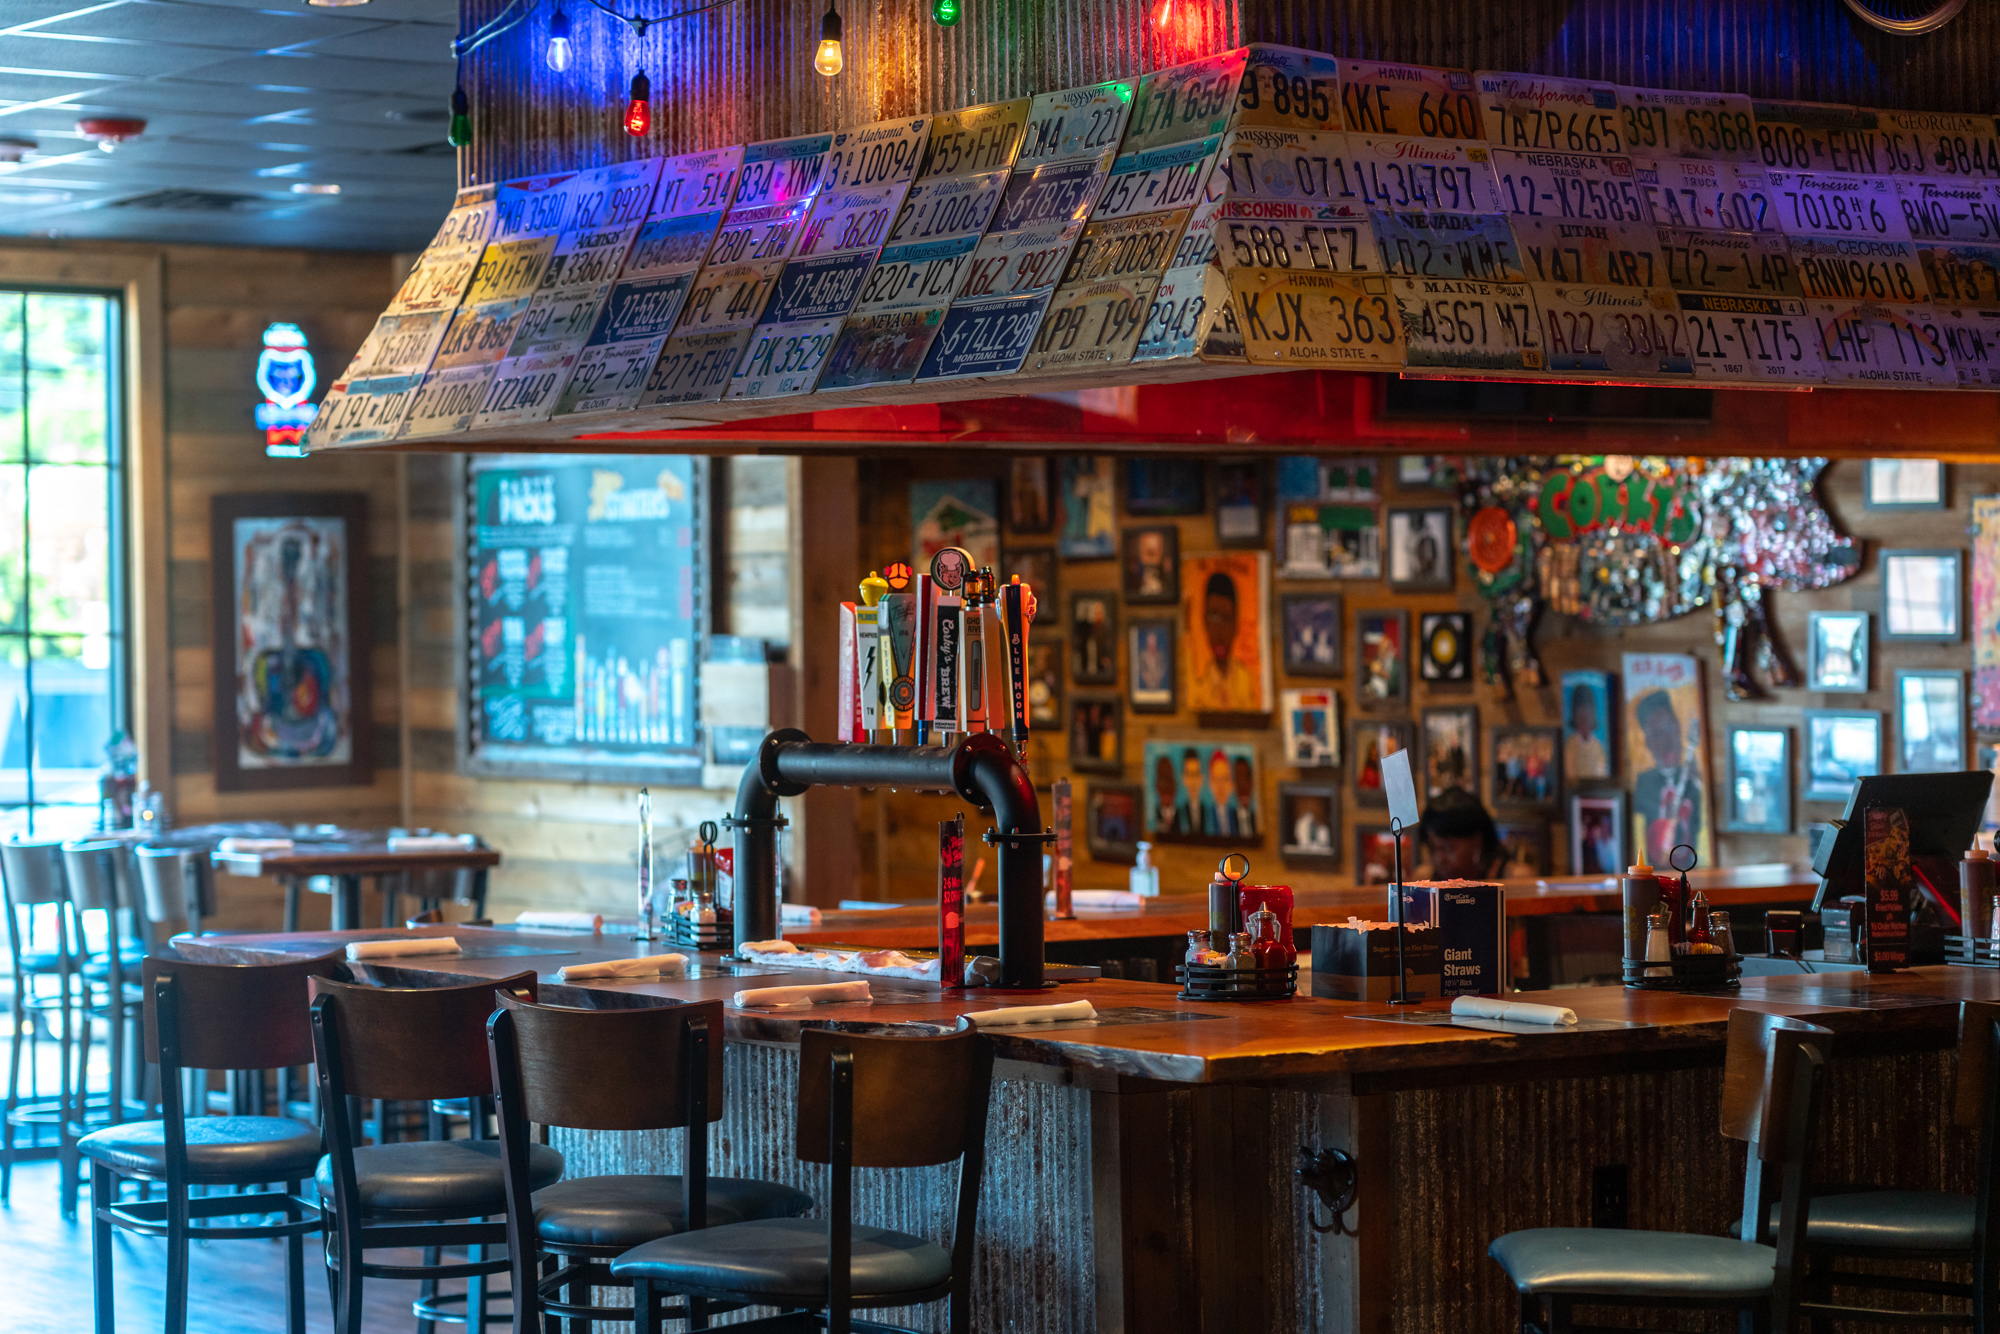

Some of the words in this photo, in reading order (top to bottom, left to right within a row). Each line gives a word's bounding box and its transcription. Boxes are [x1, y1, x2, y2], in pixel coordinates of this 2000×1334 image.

[1378, 67, 1422, 82] HAWAII
[1451, 73, 1469, 85] NOV
[1063, 87, 1106, 108] MISSISSIPPI
[1272, 72, 1330, 122] 895
[1482, 80, 1500, 93] MAY
[1508, 80, 1594, 108] California
[1643, 93, 1661, 104] LIVE
[1664, 95, 1686, 105] FREE
[1689, 96, 1702, 106] OR
[1705, 97, 1719, 107] DIE
[1131, 89, 1177, 136] 17A
[1182, 74, 1231, 122] 659
[951, 114, 975, 128] New
[974, 109, 1004, 124] Jersey
[1418, 91, 1477, 139] 660
[1083, 101, 1124, 149] 221
[1490, 105, 1621, 153] 7AZP665
[1622, 105, 1670, 148] 397
[1685, 109, 1754, 152] 6368
[852, 126, 905, 146] Alabama
[1236, 131, 1299, 149] MISSISSIPPI
[1374, 141, 1457, 161] Illinois
[1757, 125, 1811, 169] 808
[1827, 130, 1877, 174] EHV
[684, 153, 719, 170] MISSISSIPPI
[850, 137, 922, 186] 10094
[1528, 154, 1599, 170] NEBRASKA
[1616, 162, 1628, 174] 10
[1680, 163, 1716, 176] TEXAS
[607, 169, 640, 184] Illinois
[736, 162, 776, 204] 834
[783, 154, 826, 197] XNM
[1036, 167, 1068, 178] TREASURE
[1069, 165, 1089, 174] STATE
[1295, 157, 1357, 198] 071
[1549, 168, 1582, 178] TRAILER
[1769, 173, 1784, 187] SEP
[528, 178, 550, 191] OHIO
[698, 168, 736, 208] 514
[926, 178, 982, 198] Alabama
[1097, 170, 1151, 215] 457
[1154, 159, 1205, 207] XDA
[1684, 176, 1719, 189] TRUCK
[1796, 173, 1861, 191] Tennessee
[1503, 174, 1642, 222] 12-X2585
[1918, 183, 1983, 200] Tennessee
[609, 184, 650, 225] 9922
[831, 191, 882, 211] Illinois
[524, 192, 568, 232] 3580
[726, 206, 774, 224] WISCONSIN
[920, 190, 996, 237] 10063
[1212, 202, 1297, 220] WISCONSIN
[1717, 191, 1776, 233] 602
[1784, 191, 1852, 232] 7018
[1018, 216, 1063, 229] MONTANA
[1102, 216, 1165, 236] ARKANSAS
[1402, 214, 1474, 231] NEVADA
[573, 230, 621, 250] Arkansas
[1558, 224, 1609, 240] UTAH
[1685, 231, 1751, 249] Tennessee
[1000, 233, 1059, 250] Illinois
[1229, 224, 1368, 272] 588-EFZ
[1836, 240, 1910, 258] GEORGIA
[805, 258, 835, 268] TREASURE
[836, 256, 855, 265] STATE
[1088, 229, 1175, 280] 270081
[562, 246, 626, 286] 336613
[723, 265, 753, 279] HAWAII
[957, 255, 1009, 298] X62
[1009, 244, 1069, 294] 9922
[660, 278, 676, 286] STATE
[862, 263, 911, 304] 820
[918, 256, 968, 298] VCX
[1287, 274, 1334, 289] HAWAII
[1802, 257, 1916, 300] RNW9618
[549, 291, 590, 305] Tennessee
[1086, 282, 1120, 297] HAWAII
[1423, 281, 1491, 296] MAINE
[1505, 286, 1524, 297] JULY
[1563, 288, 1643, 308] Illinois
[681, 285, 723, 327] KPC
[725, 278, 774, 321] 447
[788, 306, 828, 317] MONTANA
[834, 303, 845, 312] 10
[972, 302, 1007, 313] TREASURE
[1008, 301, 1028, 309] STATE
[1703, 296, 1772, 313] NEBRASKA
[1788, 302, 1796, 313] 4
[867, 311, 919, 330] NEVADA
[1095, 295, 1147, 348] 199
[1241, 291, 1314, 342] KJX
[1329, 295, 1396, 345] 363
[1422, 300, 1488, 345] 4567
[1496, 302, 1539, 348] MZ
[616, 325, 651, 336] MONTANA
[1547, 309, 1603, 354] A22
[1688, 315, 1802, 361] 21-T175
[682, 333, 703, 347] New
[701, 333, 731, 348] Jersey
[1889, 321, 1948, 366] 113
[599, 347, 642, 362] Tennessee
[775, 333, 833, 374] 3529
[952, 352, 997, 364] MONTANA
[1005, 349, 1016, 358] 10
[1050, 352, 1079, 363] ALOHA
[1078, 350, 1106, 361] STATE
[1150, 347, 1168, 356] STATE
[1289, 346, 1327, 359] ALOHA
[1331, 347, 1366, 359] STATE
[1526, 353, 1539, 364] 16
[523, 358, 562, 372] Illinois
[646, 352, 695, 392] S27
[691, 347, 738, 389] FHB
[1724, 363, 1743, 374] 1867
[1766, 365, 1786, 376] 2017
[1971, 368, 1981, 377] 15
[566, 355, 657, 397] F92-75N
[1859, 370, 1891, 380] ALOHA
[1893, 371, 1923, 382] STATE
[745, 381, 764, 396] MEX
[777, 377, 797, 393] MEX
[581, 398, 611, 410] BLOUNT
[656, 392, 682, 405] Garden
[682, 389, 704, 402] State
[940, 619, 955, 664] Corky's
[1012, 634, 1021, 675] BLUE
[940, 667, 952, 709] BREW
[1014, 681, 1023, 719] MOON
[866, 707, 875, 715] TN
[1880, 889, 1899, 902] $5.99
[1875, 904, 1887, 912] Fried
[1877, 922, 1891, 931] Order
[1373, 946, 1391, 954] Super
[1444, 948, 1473, 961] Giant
[1874, 951, 1889, 962] $1.00
[1889, 951, 1906, 962] Wings
[1444, 964, 1481, 976] Straws
